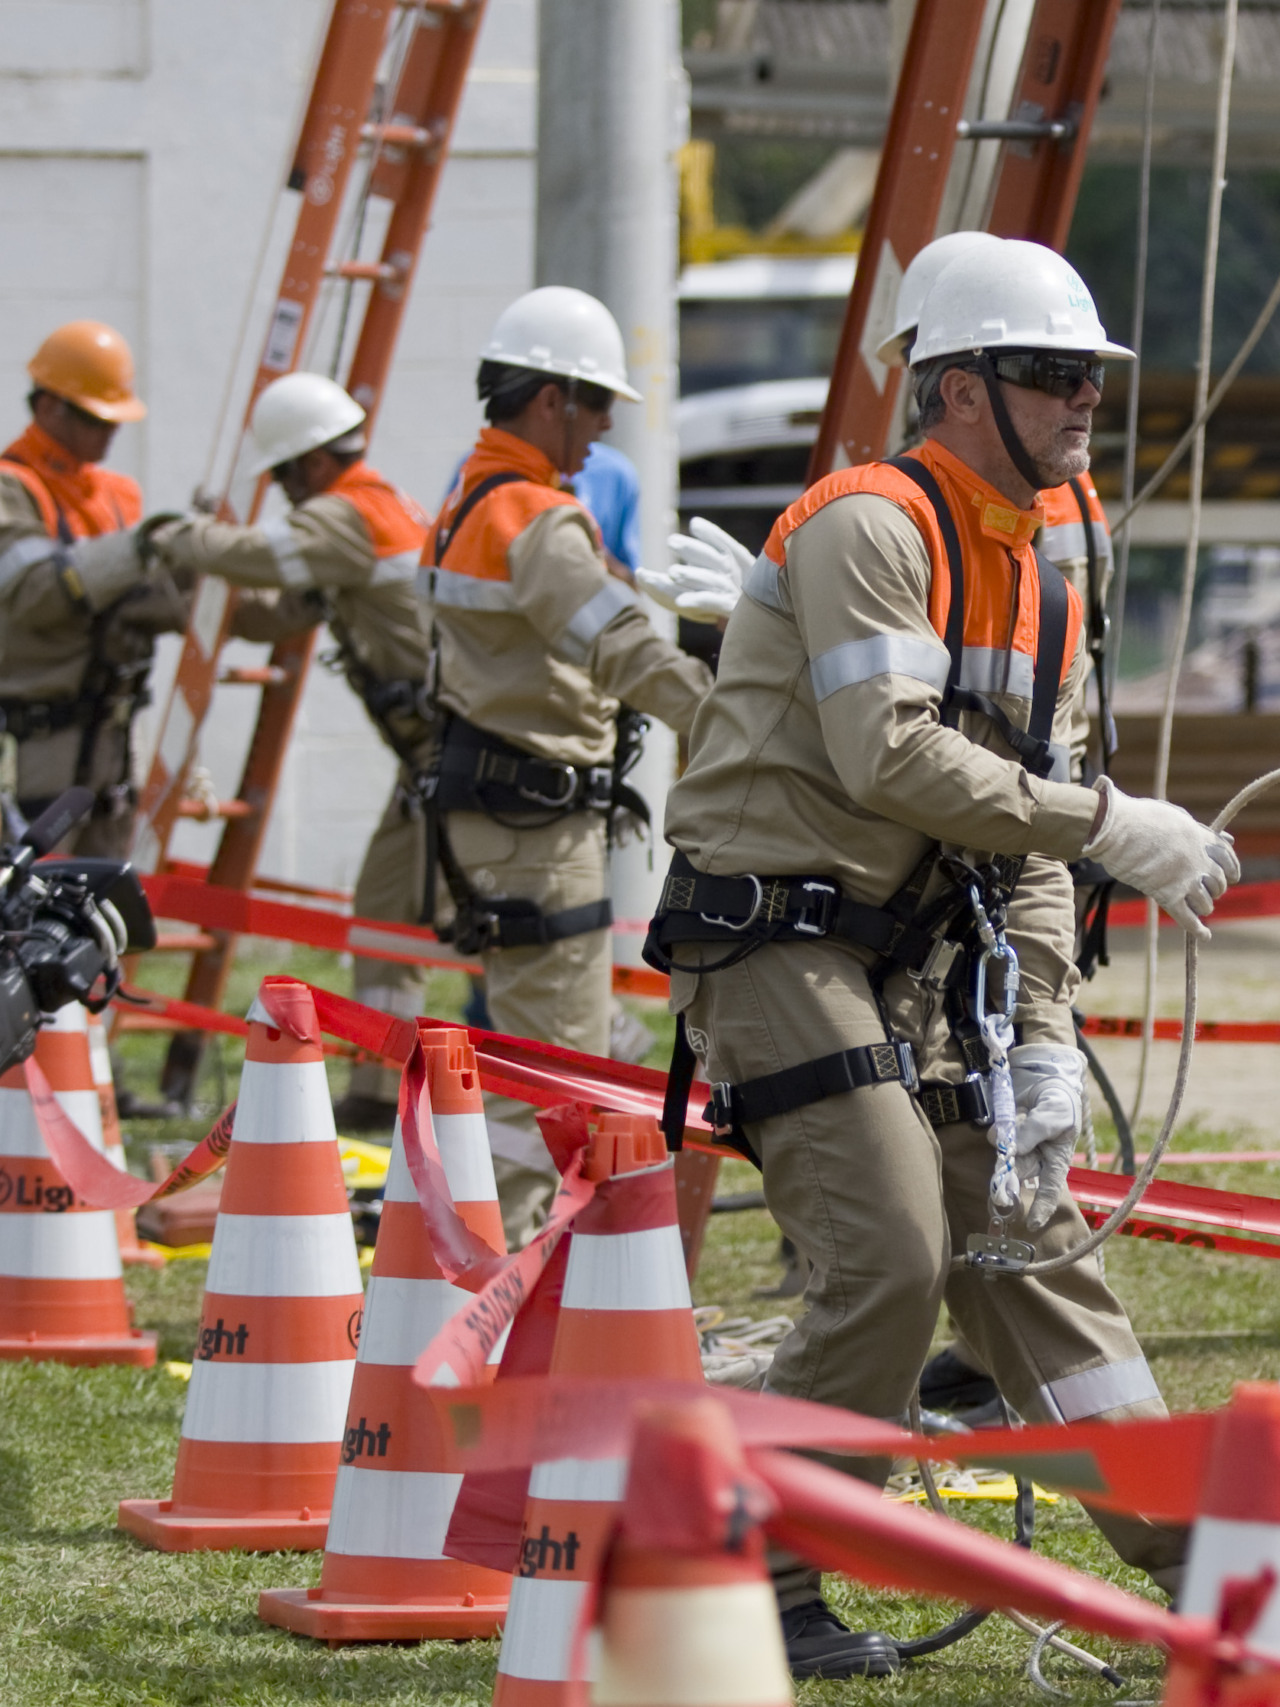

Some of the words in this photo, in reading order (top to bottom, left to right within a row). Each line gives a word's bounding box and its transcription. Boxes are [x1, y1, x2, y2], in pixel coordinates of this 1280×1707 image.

[17, 1175, 86, 1213] Lig
[342, 1417, 392, 1464] ght
[520, 1521, 581, 1578] ght
